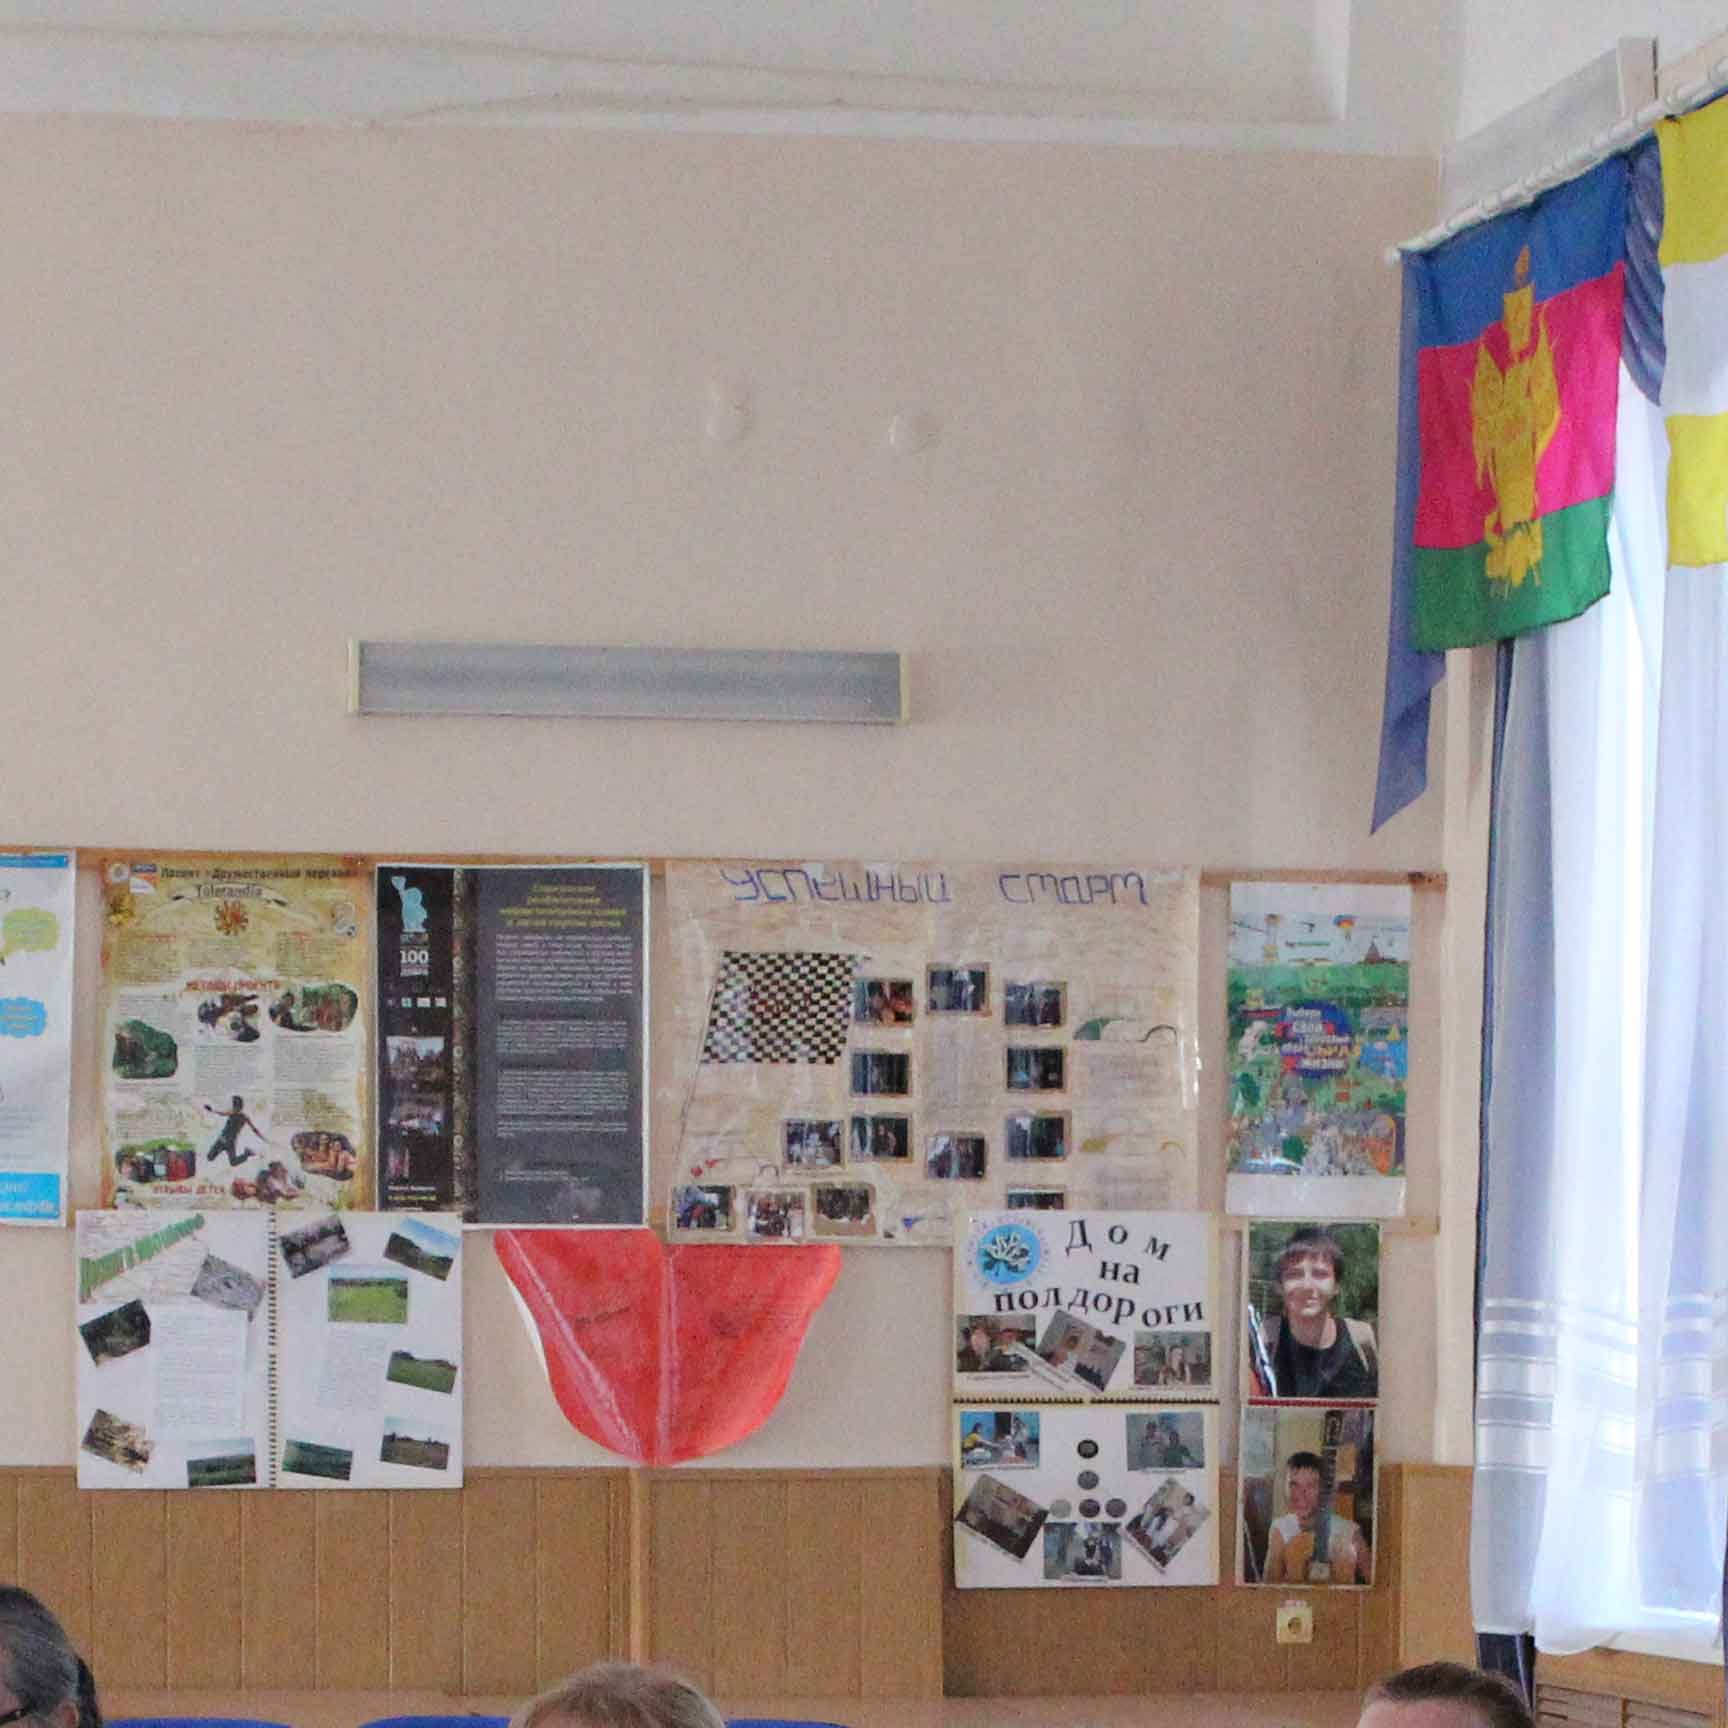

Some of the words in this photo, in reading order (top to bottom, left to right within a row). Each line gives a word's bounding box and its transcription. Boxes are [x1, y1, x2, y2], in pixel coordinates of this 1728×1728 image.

[400, 951, 429, 964] 100
[1065, 1219, 1172, 1261] Дом
[1099, 1260, 1140, 1285] на
